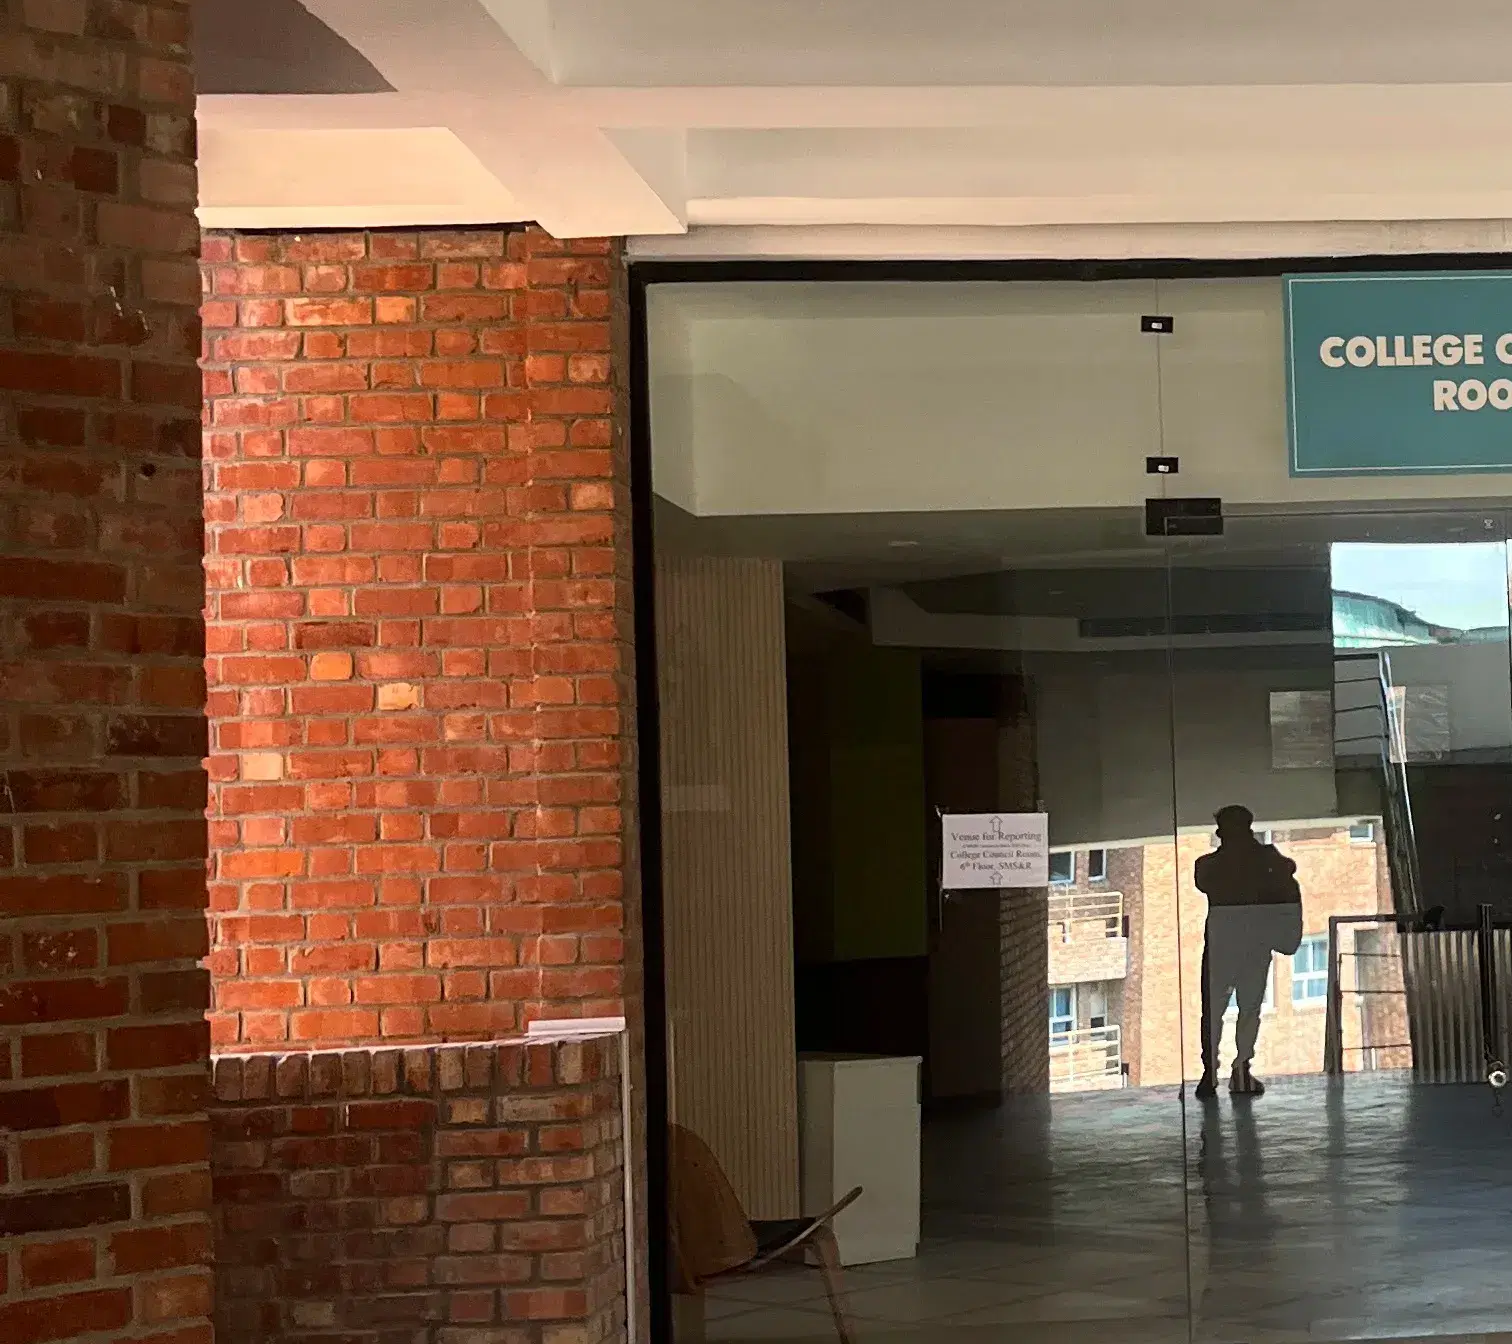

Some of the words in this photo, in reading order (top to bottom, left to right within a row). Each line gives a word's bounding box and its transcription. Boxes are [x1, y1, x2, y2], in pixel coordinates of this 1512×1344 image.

[1319, 334, 1485, 368] COLLEGE
[950, 832, 980, 842] Venue
[982, 832, 995, 841] for
[998, 831, 1042, 843] Reporting
[950, 851, 980, 861] College
[982, 850, 1014, 859] Council
